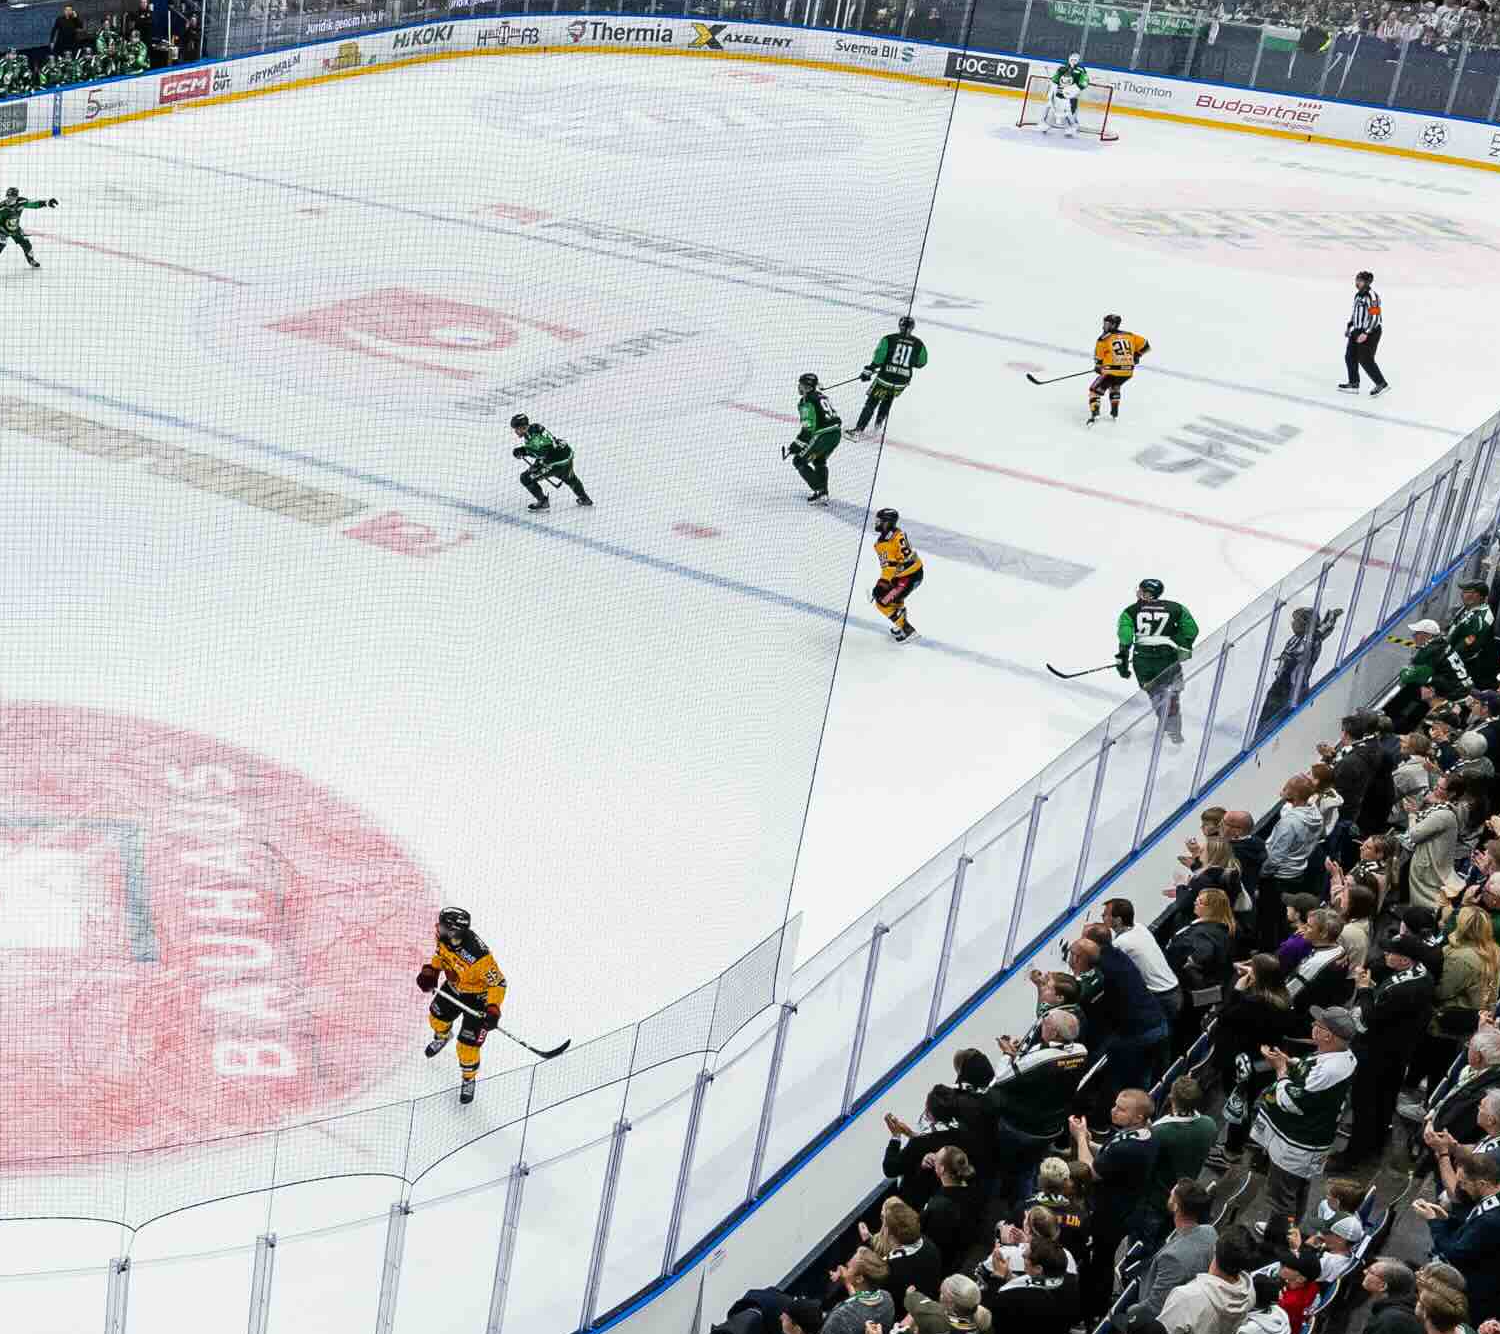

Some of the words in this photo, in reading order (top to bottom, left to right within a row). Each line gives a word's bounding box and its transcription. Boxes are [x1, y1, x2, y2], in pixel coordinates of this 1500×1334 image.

[589, 21, 674, 45] Thermia
[722, 32, 794, 50] AXELENT
[212, 78, 231, 92] OUT
[213, 67, 231, 80] ALL
[161, 75, 211, 102] CCM
[1196, 93, 1322, 125] Budpartner
[1136, 611, 1171, 637] 67
[163, 755, 300, 1079] BAUHAUS
